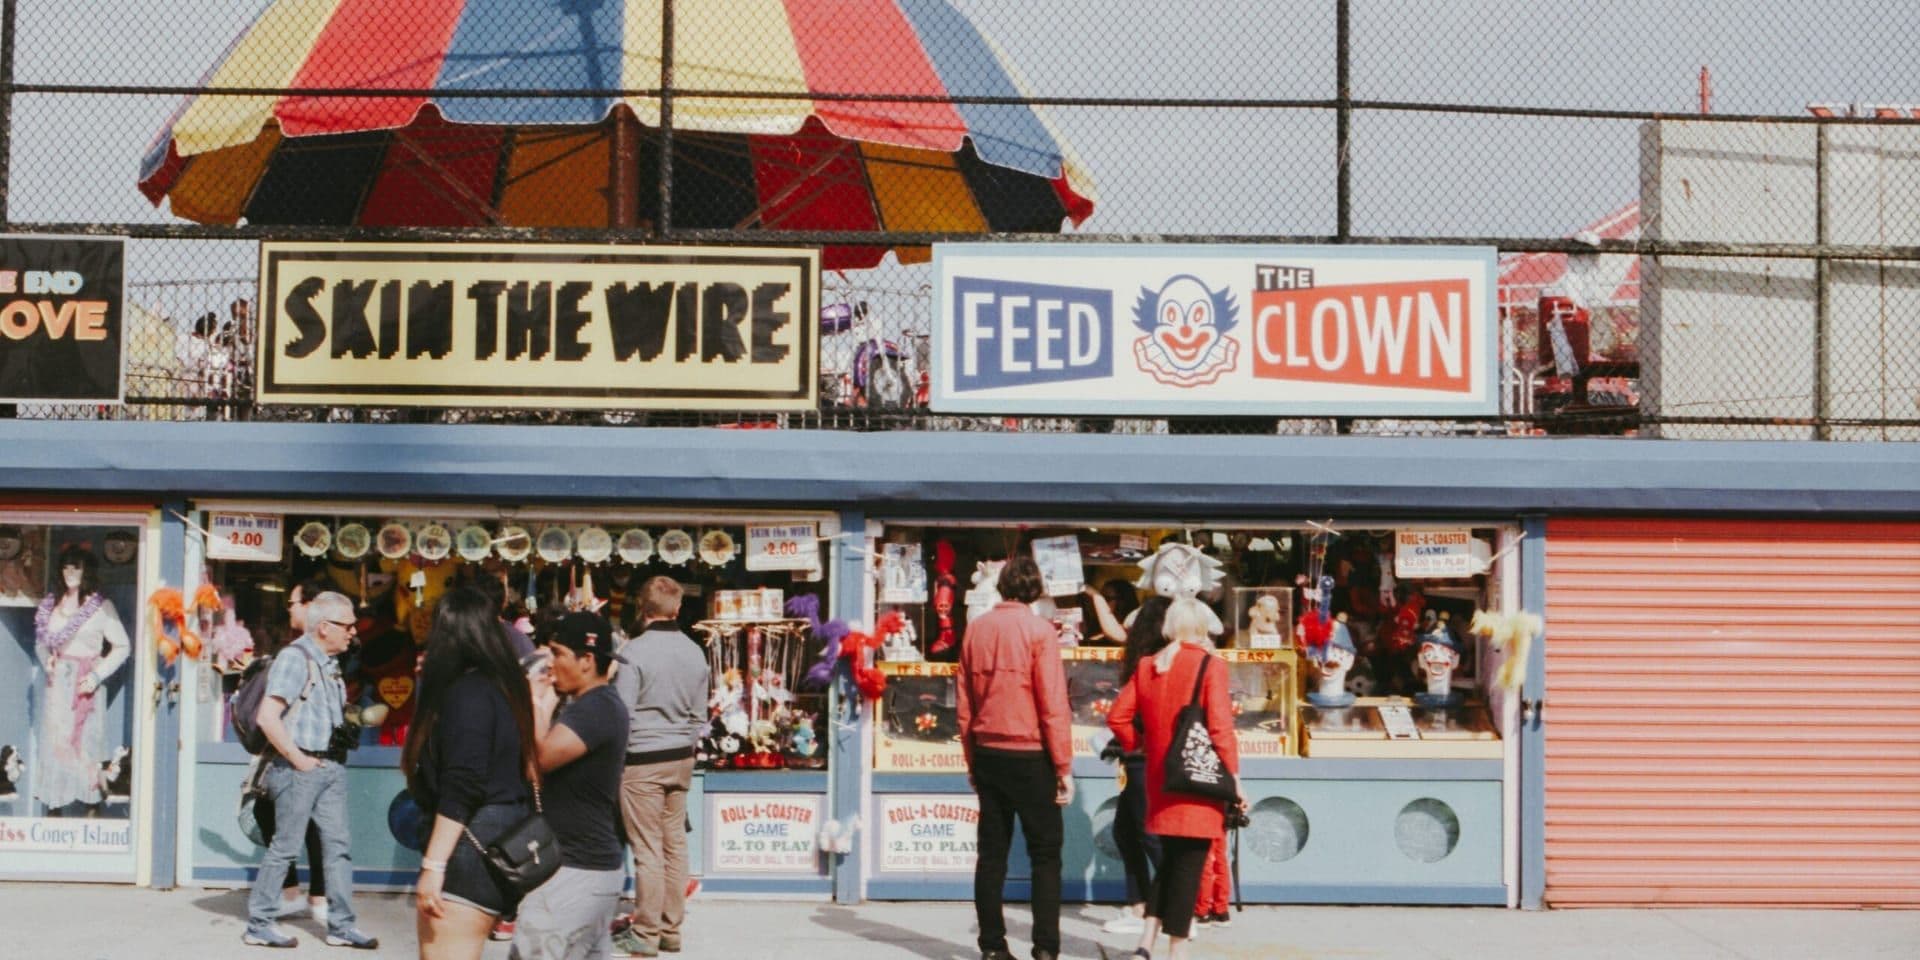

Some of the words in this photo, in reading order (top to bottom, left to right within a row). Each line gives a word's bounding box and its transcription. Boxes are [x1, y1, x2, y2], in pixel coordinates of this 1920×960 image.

[24, 271, 83, 294] END
[1259, 267, 1312, 289] THE
[0, 300, 108, 340] OVE
[284, 276, 453, 361] SKIN
[467, 280, 592, 362] THE
[604, 280, 792, 364] WIRE
[963, 292, 1101, 377] FEED
[1255, 291, 1463, 379] CLOWN
[1401, 534, 1467, 545] ROLL-A-COASTER
[1416, 547, 1449, 555] GAME
[1237, 651, 1275, 663] EASY
[931, 664, 959, 676] EAS
[721, 804, 812, 824] ROLL-A-COASTER
[888, 803, 980, 824] ROLL-A-COASTER
[31, 822, 75, 848] Coney
[83, 823, 130, 846] Island
[744, 823, 788, 836] GAME
[911, 823, 955, 836] GAME
[744, 840, 765, 851] TO
[771, 840, 810, 851] PLAY
[912, 841, 933, 852] TO
